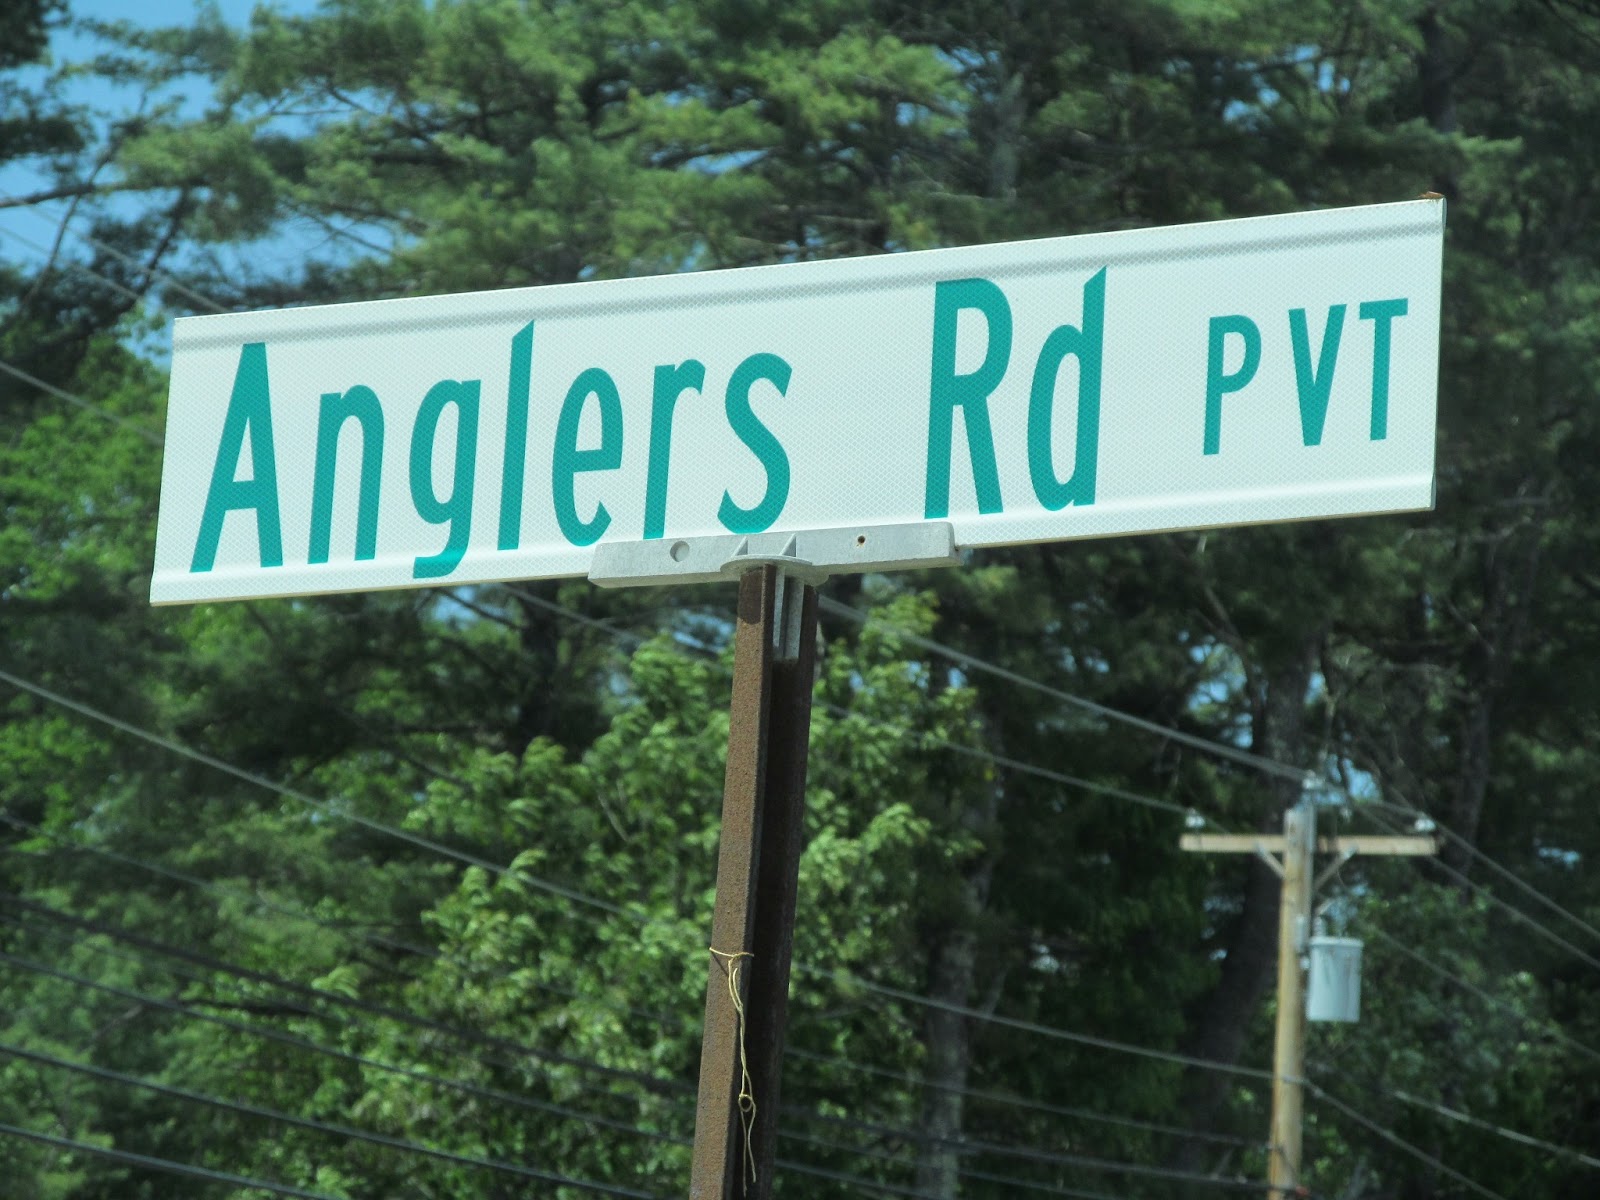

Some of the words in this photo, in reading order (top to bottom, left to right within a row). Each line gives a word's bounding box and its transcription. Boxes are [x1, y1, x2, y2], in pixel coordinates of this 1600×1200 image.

[189, 319, 794, 579] Anglers
[923, 266, 1107, 520] Rd
[1202, 297, 1409, 456] PVT
